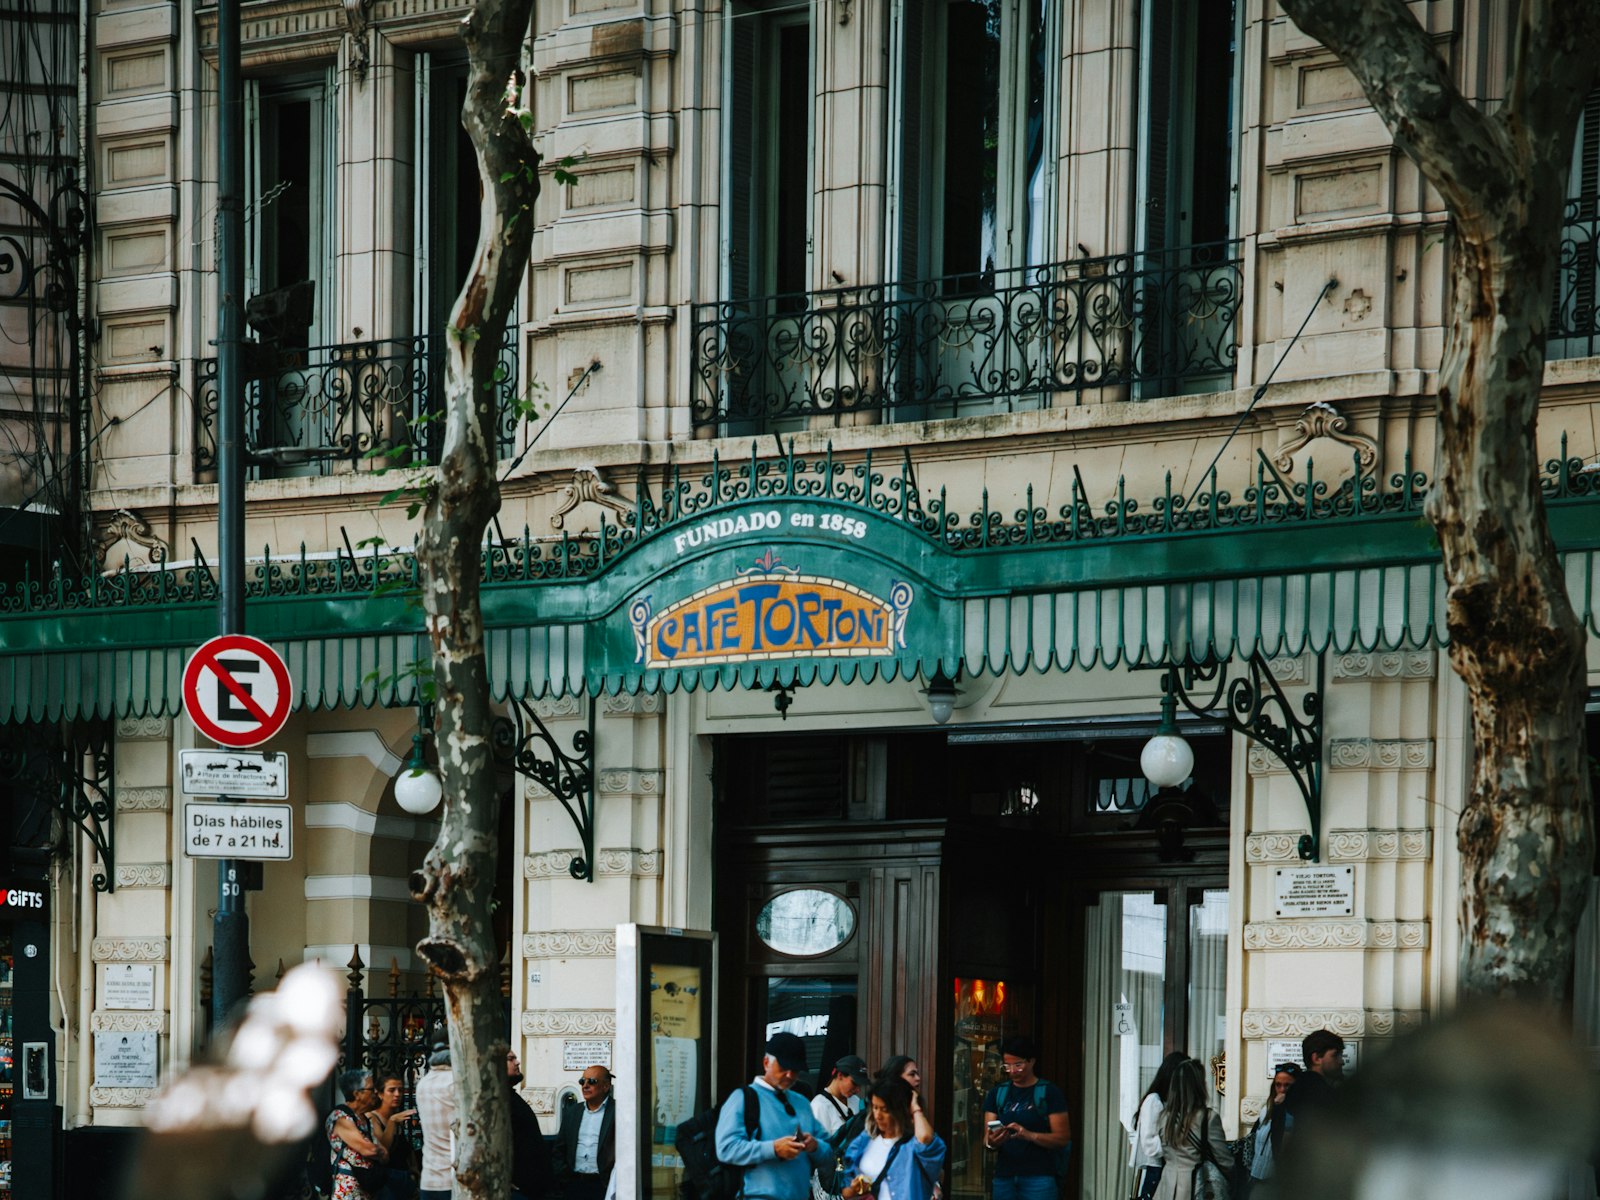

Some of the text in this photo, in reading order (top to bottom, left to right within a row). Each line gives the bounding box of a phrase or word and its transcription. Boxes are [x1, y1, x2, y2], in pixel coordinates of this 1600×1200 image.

[674, 510, 867, 554] FUNDADO en 1858
[656, 583, 885, 660] CAFE TORTONI
[217, 659, 260, 722] E
[193, 814, 283, 829] Días hábiles
[192, 834, 284, 848] de 7 a 21 hs.
[222, 883, 240, 896] 50
